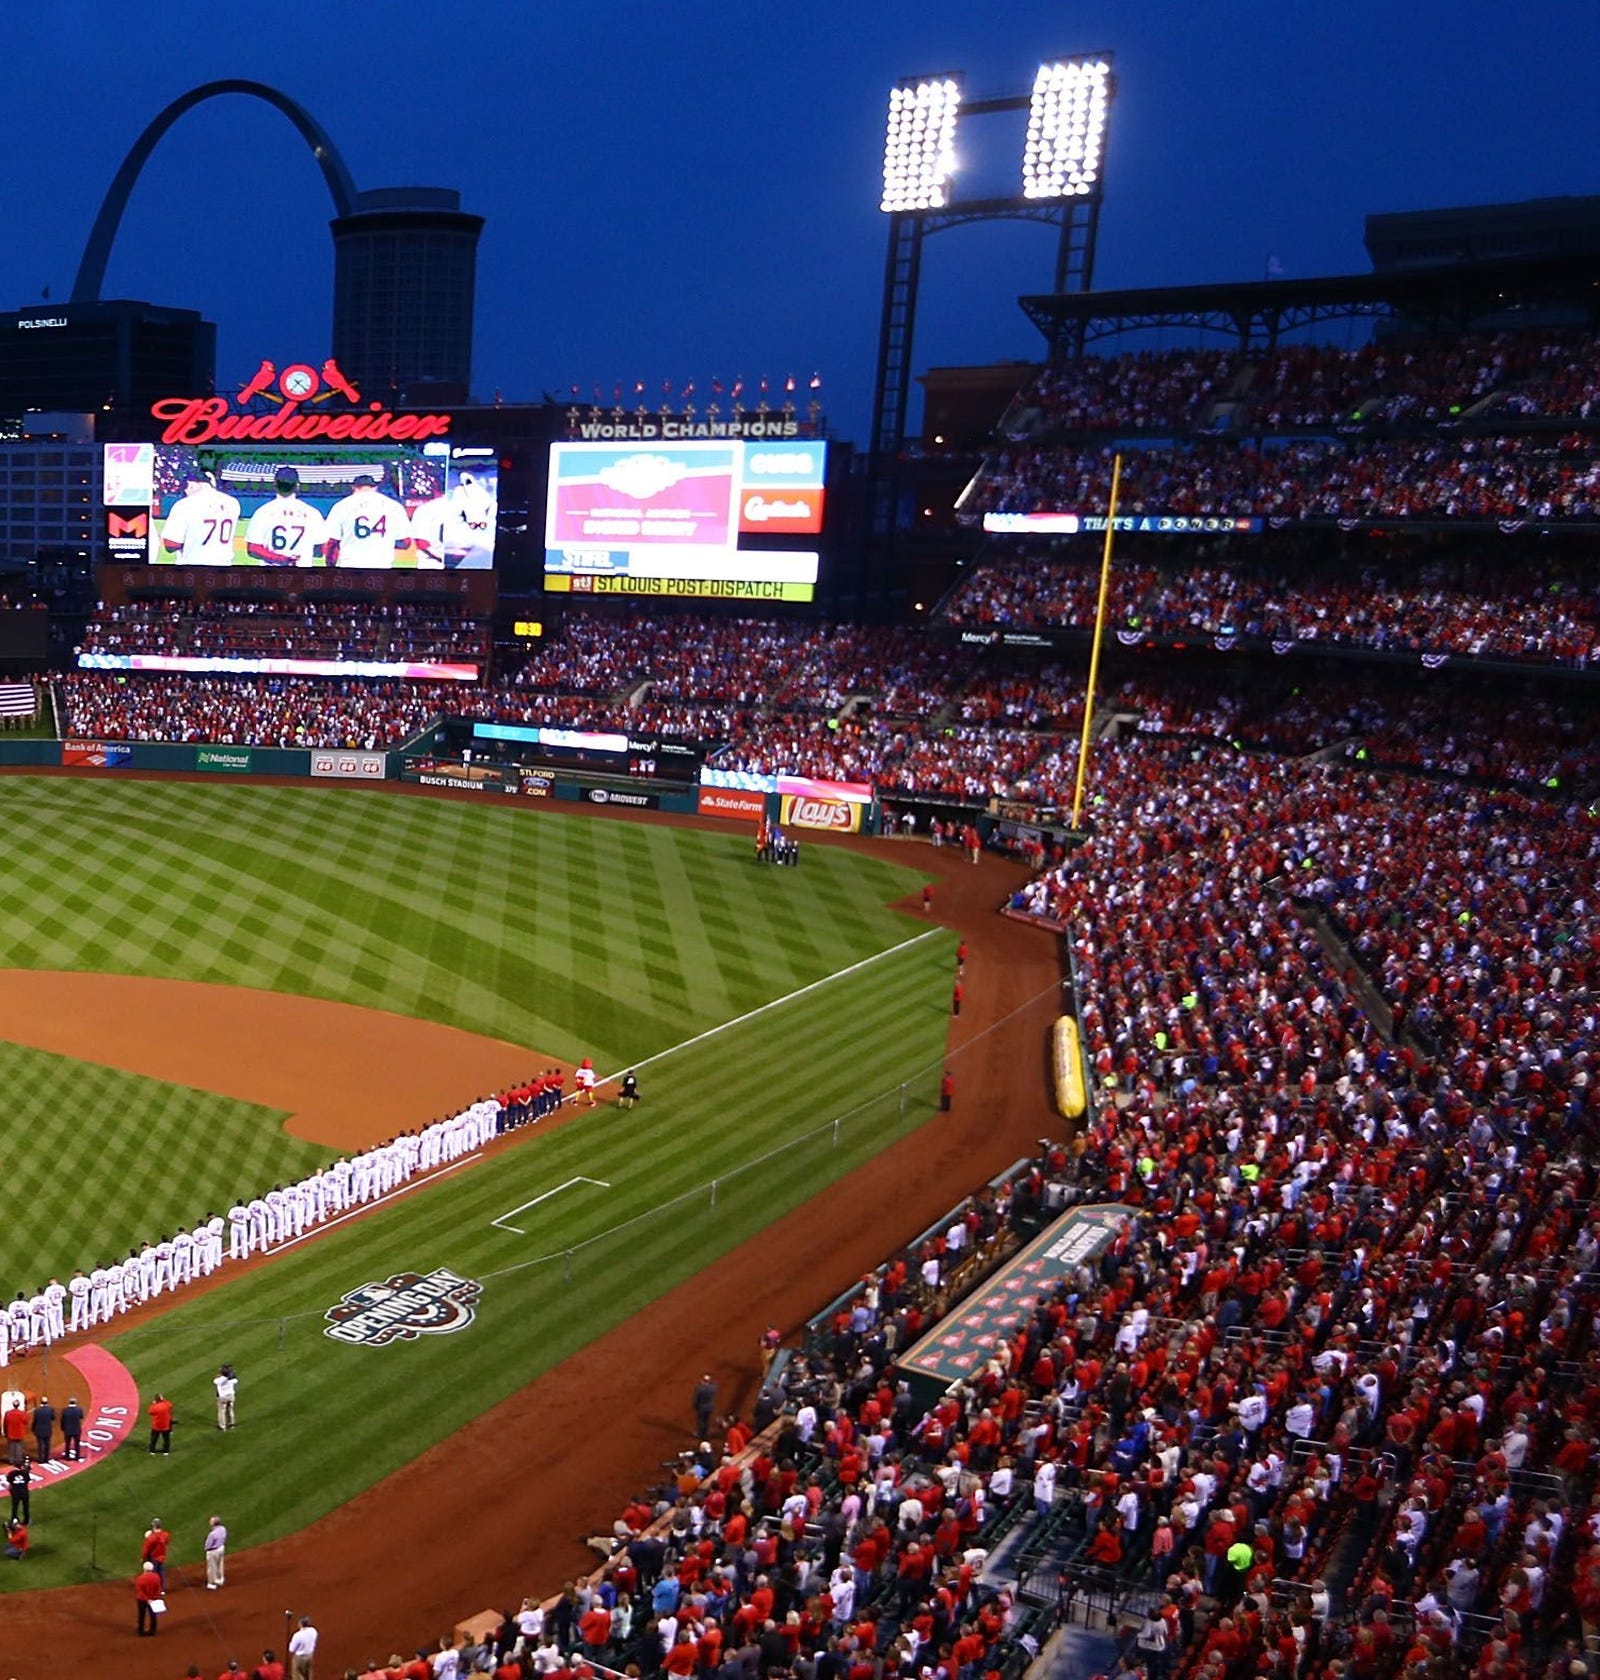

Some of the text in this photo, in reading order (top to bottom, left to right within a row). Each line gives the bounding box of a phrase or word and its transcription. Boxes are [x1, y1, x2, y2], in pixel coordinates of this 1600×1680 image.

[18, 319, 67, 330] POLSINELLI
[151, 399, 451, 444] Budweiser
[580, 421, 799, 439] WORLD CHAMPIONS
[354, 514, 387, 539] 64
[1139, 518, 1150, 531] A
[202, 518, 233, 546] 70
[271, 525, 306, 551] 67
[620, 578, 662, 593] LOUIS
[666, 580, 783, 598] POST-DISPATCH
[961, 632, 992, 645] Mercy
[64, 742, 131, 754] Bank of America
[629, 741, 652, 753] Mercy
[209, 753, 249, 764] National
[317, 762, 332, 771] 66
[340, 762, 356, 772] 66
[363, 763, 379, 773] 66
[420, 775, 484, 791] BUSCH STADIUM
[609, 794, 649, 806] MIDWEST
[328, 1269, 467, 1342] OPENING DAY
